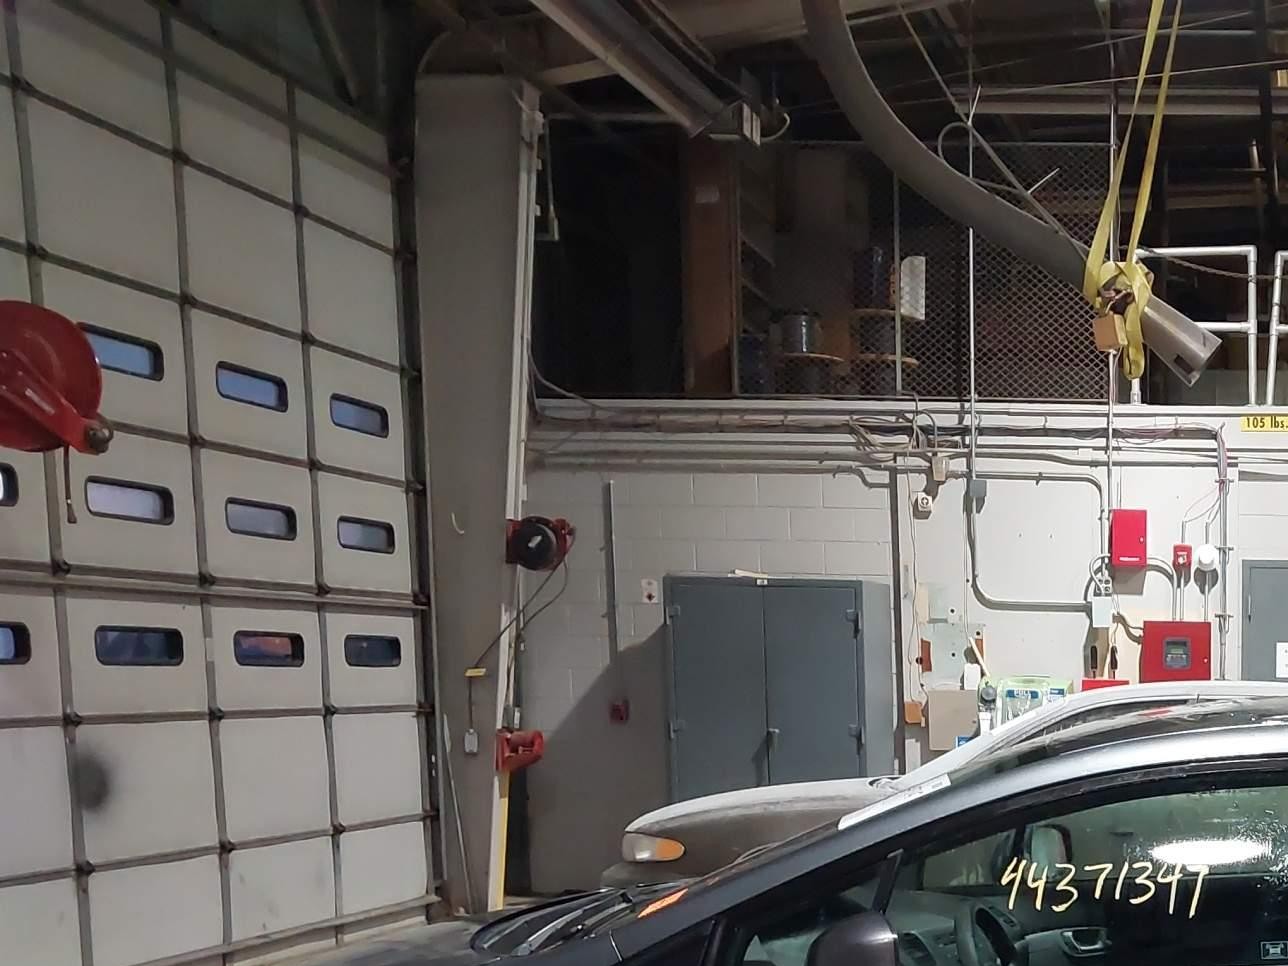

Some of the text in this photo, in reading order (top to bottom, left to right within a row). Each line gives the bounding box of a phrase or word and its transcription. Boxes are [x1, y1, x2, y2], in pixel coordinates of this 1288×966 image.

[1246, 416, 1265, 428] 105
[1270, 415, 1288, 429] lbs.
[1000, 856, 1210, 919] 44371347
